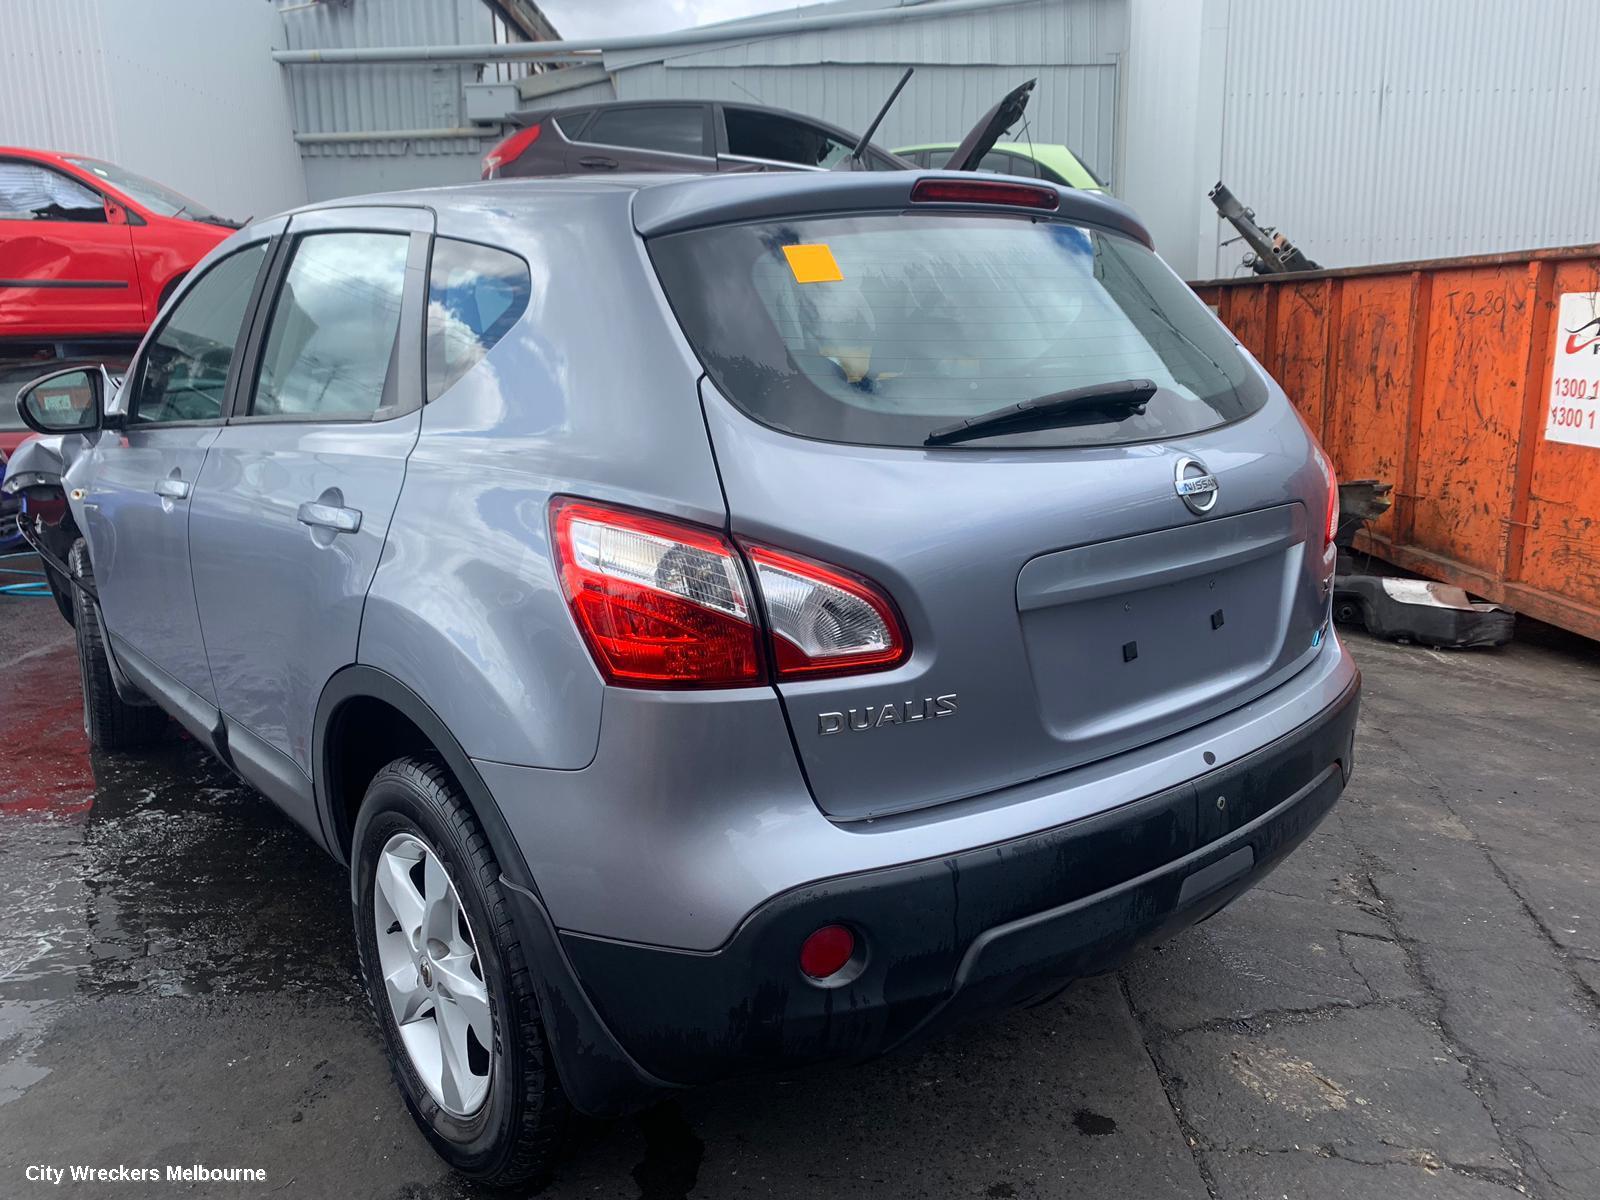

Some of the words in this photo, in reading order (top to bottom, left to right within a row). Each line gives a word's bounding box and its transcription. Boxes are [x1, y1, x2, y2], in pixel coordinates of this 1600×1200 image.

[1555, 378, 1587, 398] 1300
[1552, 406, 1583, 428] 1300
[1183, 478, 1216, 491] NISSAN
[818, 693, 957, 735] DUALIS
